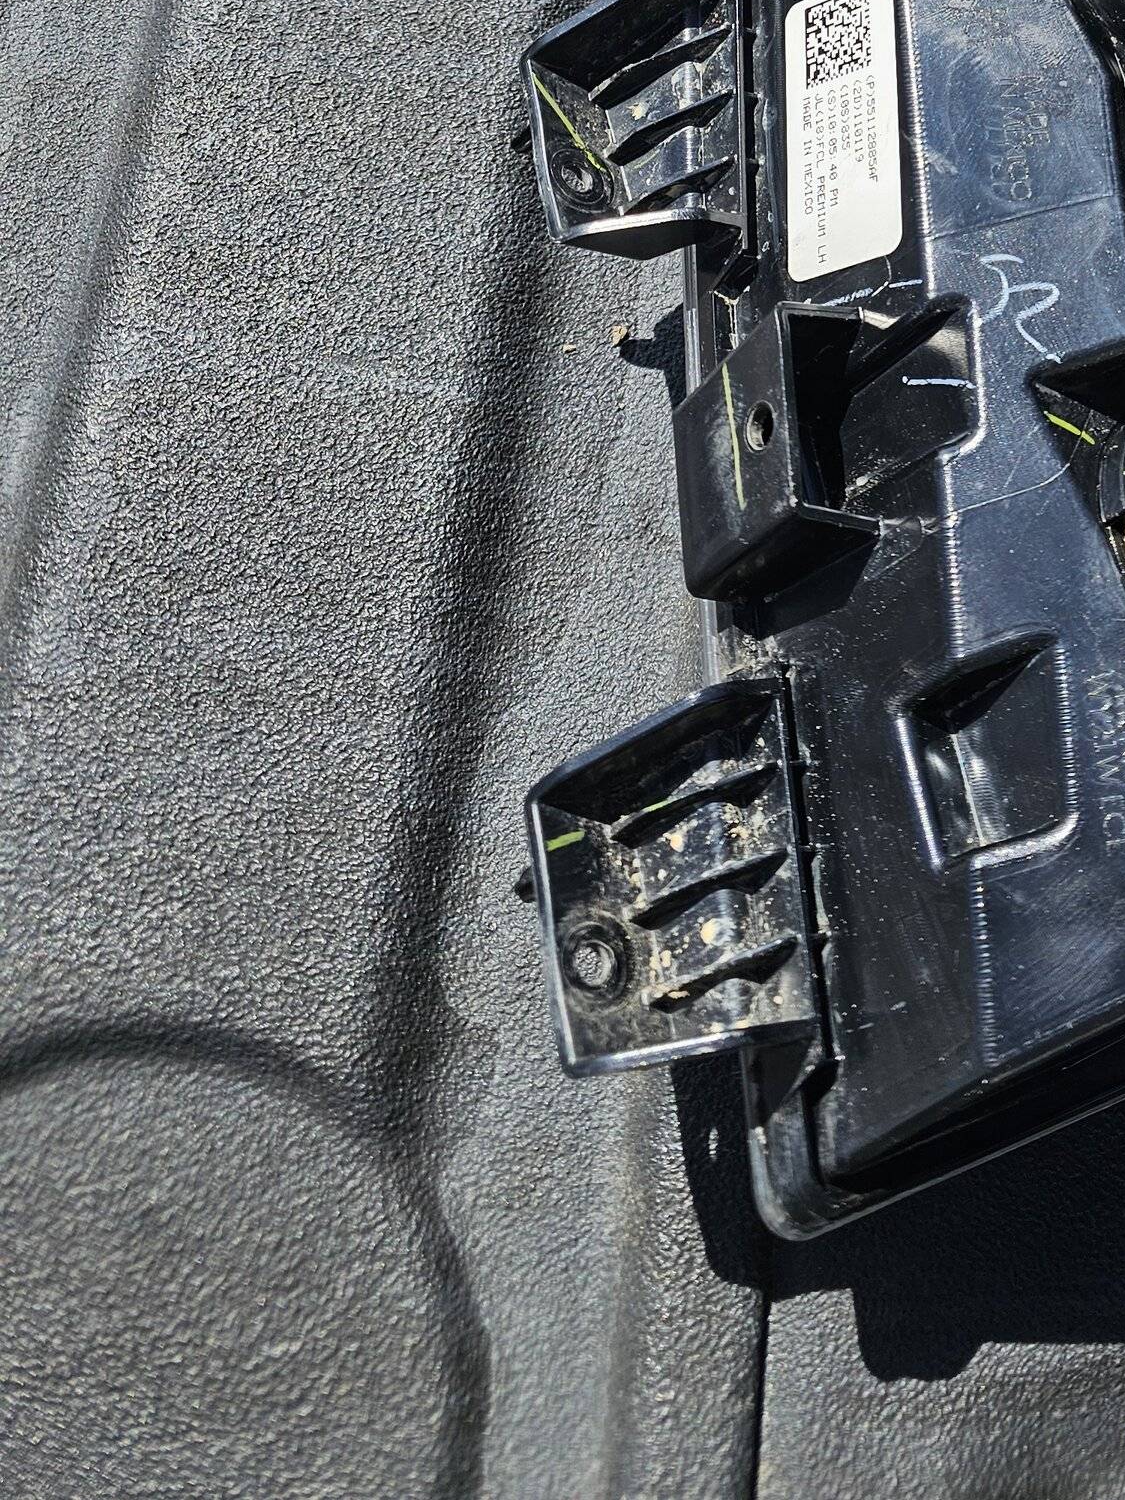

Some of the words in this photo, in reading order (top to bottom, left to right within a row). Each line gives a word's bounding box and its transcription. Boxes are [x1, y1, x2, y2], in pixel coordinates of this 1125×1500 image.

[802, 95, 812, 132] MADE
[814, 92, 826, 169] JL(18)FCL
[840, 84, 851, 151] (10S)835
[852, 79, 865, 164] (2D)110119
[864, 74, 879, 183] (P)55112885AF
[803, 141, 813, 157] IN
[803, 163, 814, 216] MEXICO
[816, 174, 827, 238] PREMIUM
[829, 187, 839, 208] PM
[817, 244, 828, 264] LH
